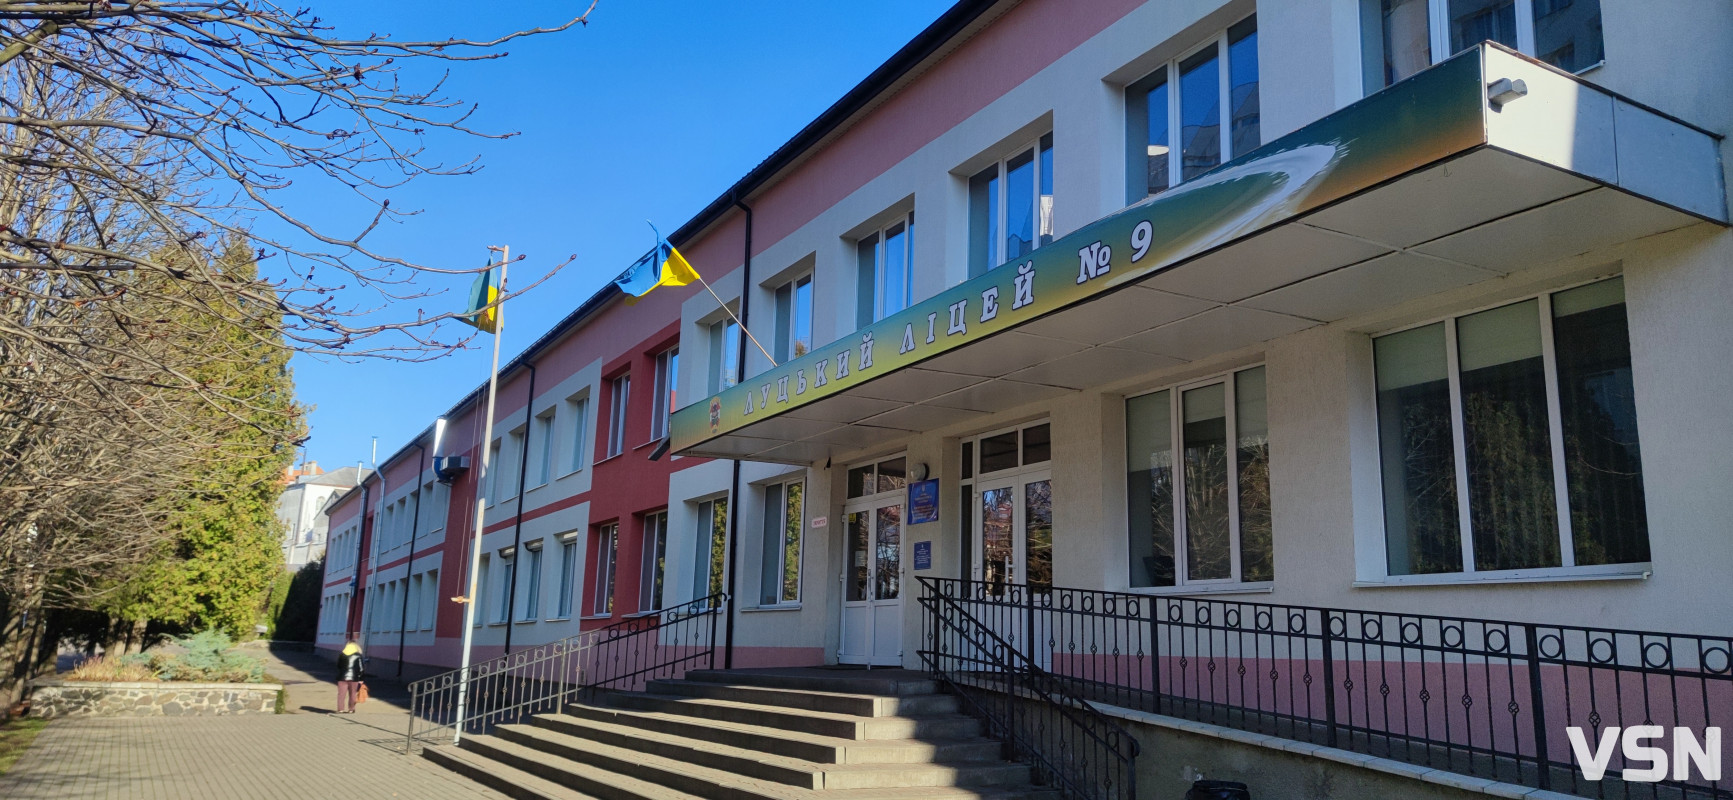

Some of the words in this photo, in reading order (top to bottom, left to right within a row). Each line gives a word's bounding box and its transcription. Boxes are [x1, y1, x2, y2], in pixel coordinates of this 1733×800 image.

[743, 331, 874, 416] ЛУЦЬКИЙ
[899, 259, 1036, 355] ЛІЦЕЙ
[1076, 240, 1112, 285] №
[1130, 219, 1154, 263] 9
